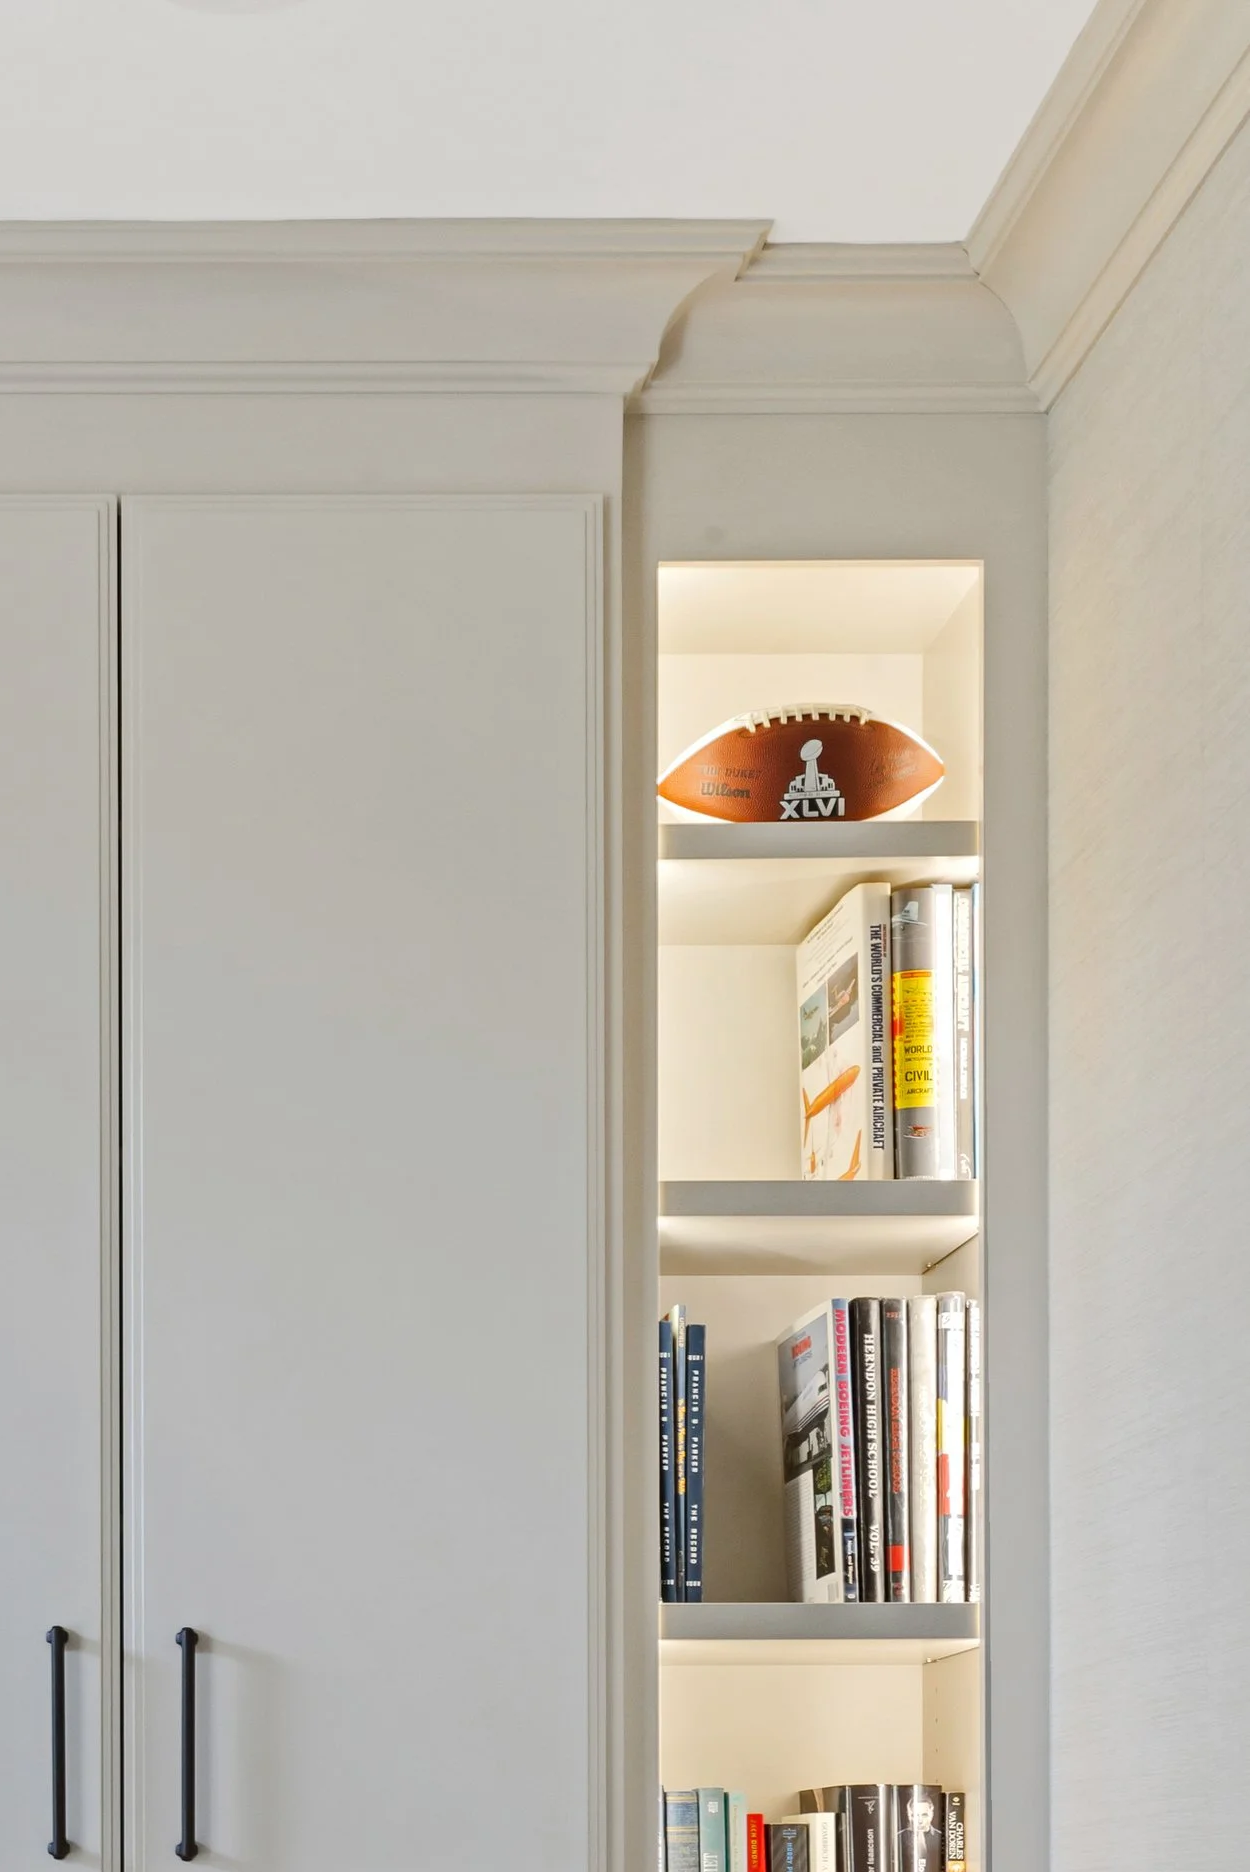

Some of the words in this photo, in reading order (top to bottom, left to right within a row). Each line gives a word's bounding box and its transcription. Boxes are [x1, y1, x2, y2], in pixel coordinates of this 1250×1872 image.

[701, 782, 750, 798] Wilson
[779, 797, 846, 820] XLVI
[870, 924, 881, 940] THE
[871, 942, 883, 982] WORLD'S
[871, 984, 884, 1044] COMMERCIAL
[872, 1045, 883, 1063] and
[904, 1045, 933, 1055] WORLD
[872, 1067, 884, 1103] PRIVATE
[905, 1071, 933, 1082] CIVIL
[872, 1105, 884, 1150] AIRCRAFT
[835, 1308, 848, 1374] MODERN
[864, 1334, 876, 1400] HERNDON
[838, 1380, 851, 1437] BOEING
[866, 1404, 877, 1439] HIGH
[891, 1421, 901, 1449] HIGH
[840, 1444, 854, 1517] JETLINERS
[867, 1442, 879, 1498] SCHOOL
[870, 1524, 880, 1554] VOL.
[870, 1557, 881, 1571] 39
[948, 1811, 957, 1829] VAN
[867, 1828, 875, 1864] Isaacson
[948, 1830, 957, 1859] DOREN
[956, 1822, 965, 1859] CHARLES
